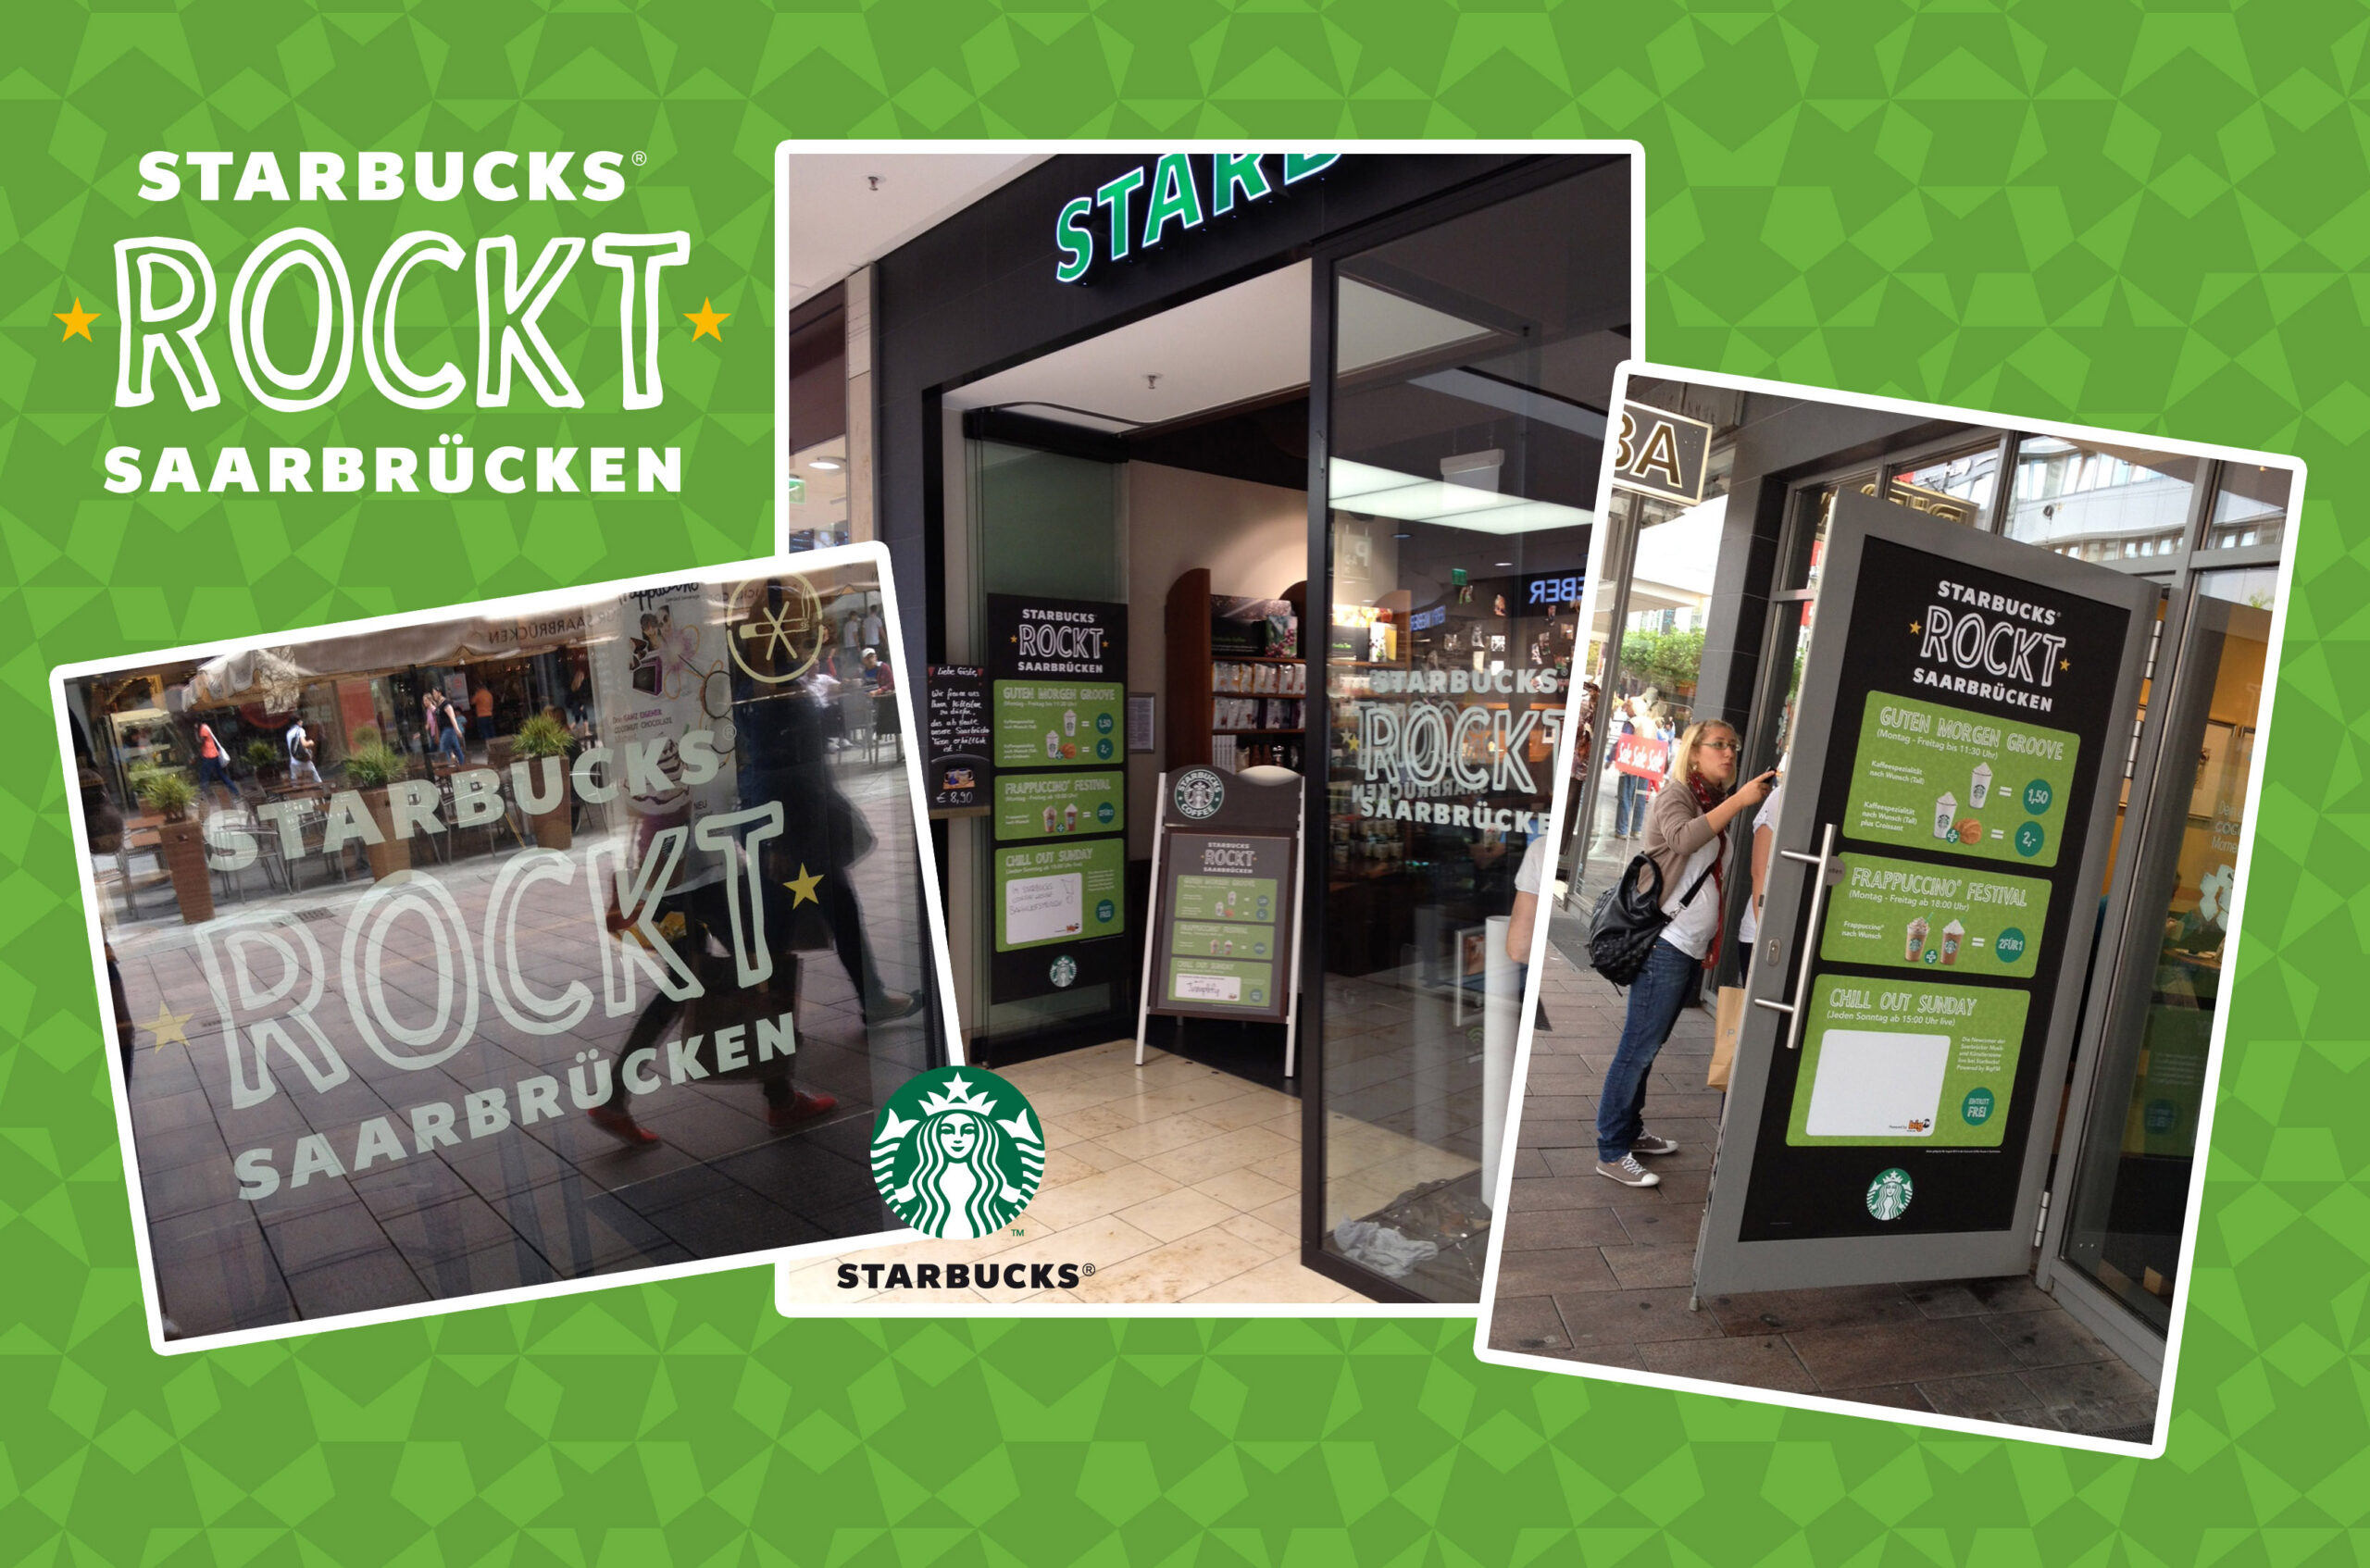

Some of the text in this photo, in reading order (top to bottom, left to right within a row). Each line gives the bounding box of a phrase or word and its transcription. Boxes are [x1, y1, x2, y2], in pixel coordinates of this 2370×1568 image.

[1018, 623, 1104, 659] ROCKT
[1920, 604, 2066, 688] ROCKT
[1017, 661, 1104, 674] SAARBRÜCKEN
[1913, 667, 2052, 713] SAARBRÜCKEN
[1879, 706, 2064, 761] GUTEN MORGEN GROOVE
[1877, 728, 1910, 745] (Montag
[1917, 737, 1945, 752] Freitag
[1946, 742, 1957, 752] bis
[1960, 745, 1981, 756] 11:30
[1982, 749, 1998, 761] Uhr)
[1869, 770, 1885, 778] nach
[1886, 772, 1909, 782] Wunsch
[1871, 760, 1923, 776] Kaffeespezialität
[1177, 771, 1223, 793] STARBUCKS
[2027, 789, 2049, 804] 1,50
[1180, 803, 1215, 817] COFFEE
[1864, 801, 1915, 815] Kaffeespezialität
[1860, 819, 1903, 832] plus Croissant
[1862, 811, 1877, 819] nach
[1877, 812, 1902, 823] Wunsch
[2022, 831, 2037, 848] 2,-
[1035, 852, 1055, 864] OUT
[1849, 890, 1883, 903] (Montag
[1890, 894, 1917, 907] Freitag
[1918, 898, 1928, 906] ab
[1931, 900, 1952, 909] 18:00
[1953, 902, 1970, 913] Uhr)
[1966, 882, 2027, 907] FESTIVAL
[1858, 931, 1882, 940] Wunsch
[194, 801, 784, 1110] ROCKT
[1829, 988, 1977, 1016] CHILL OUT SUNDAY
[1827, 1010, 1956, 1027] (Jeden Sonntag ab 15:00 Uhr live)
[233, 1012, 798, 1201] SAARBRÜCKEN
[1967, 1106, 1987, 1118] FREI
